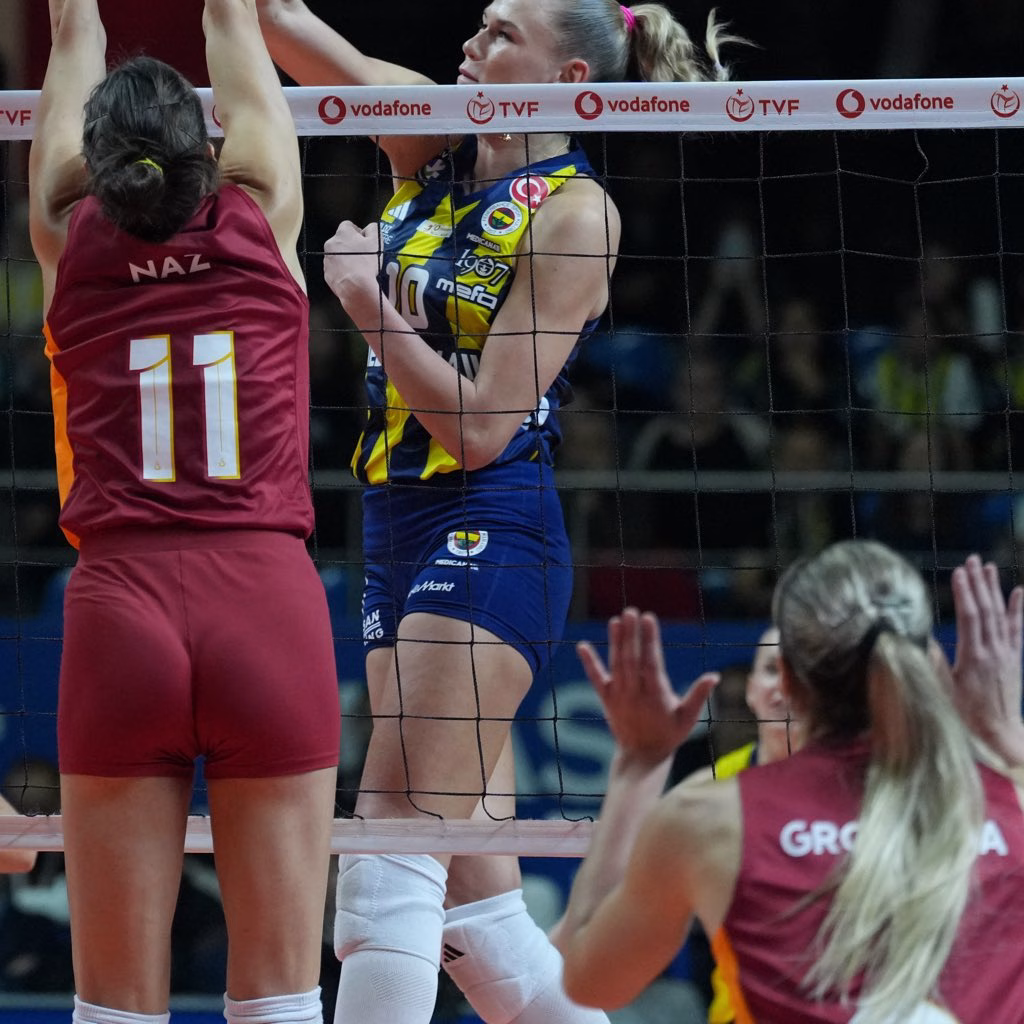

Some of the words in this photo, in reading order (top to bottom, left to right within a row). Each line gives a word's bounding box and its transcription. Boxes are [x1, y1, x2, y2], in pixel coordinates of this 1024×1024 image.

[350, 99, 432, 117] vodafone
[498, 101, 539, 118] TVF
[607, 95, 691, 114] vodafone
[759, 99, 800, 116] TVF
[870, 92, 955, 112] vodafone
[128, 253, 212, 283] NAZ
[129, 330, 241, 483] 11
